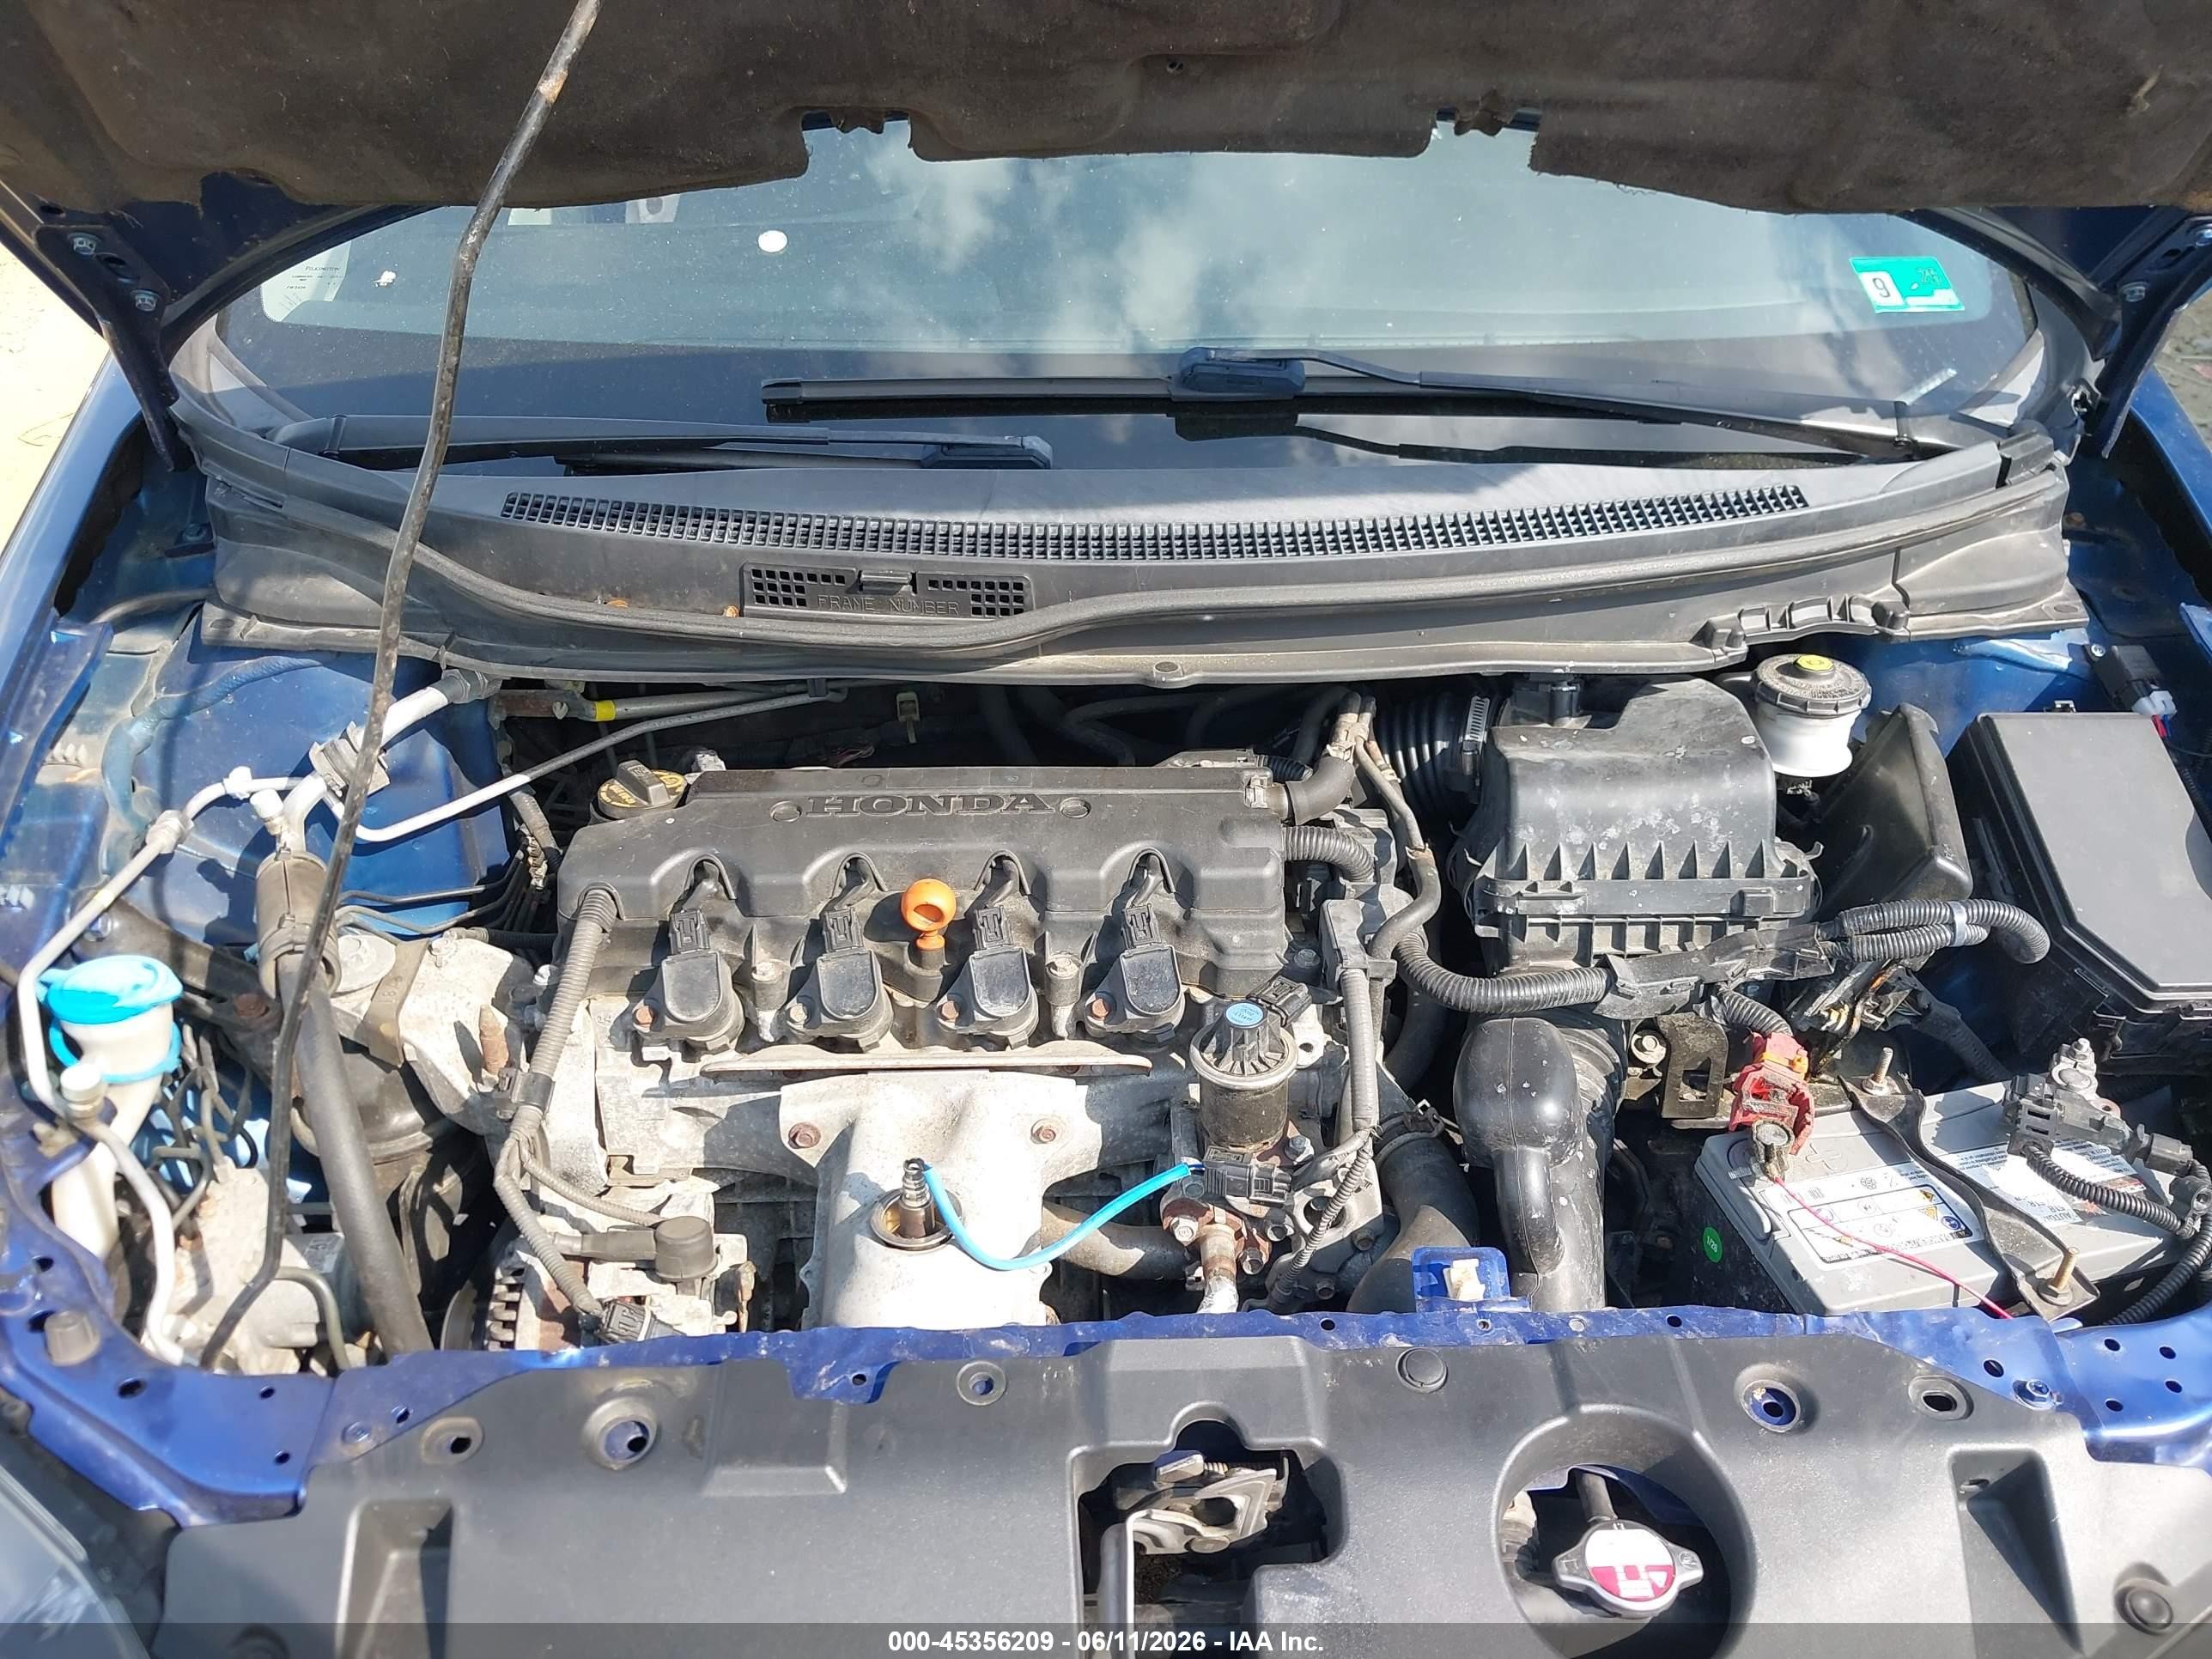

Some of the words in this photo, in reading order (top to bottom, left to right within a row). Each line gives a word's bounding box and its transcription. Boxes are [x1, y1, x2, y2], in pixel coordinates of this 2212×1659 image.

[1872, 276, 1891, 298] 9
[817, 594, 876, 612] FRAME
[888, 597, 960, 616] NUMBER
[805, 793, 1054, 817] HONDA
